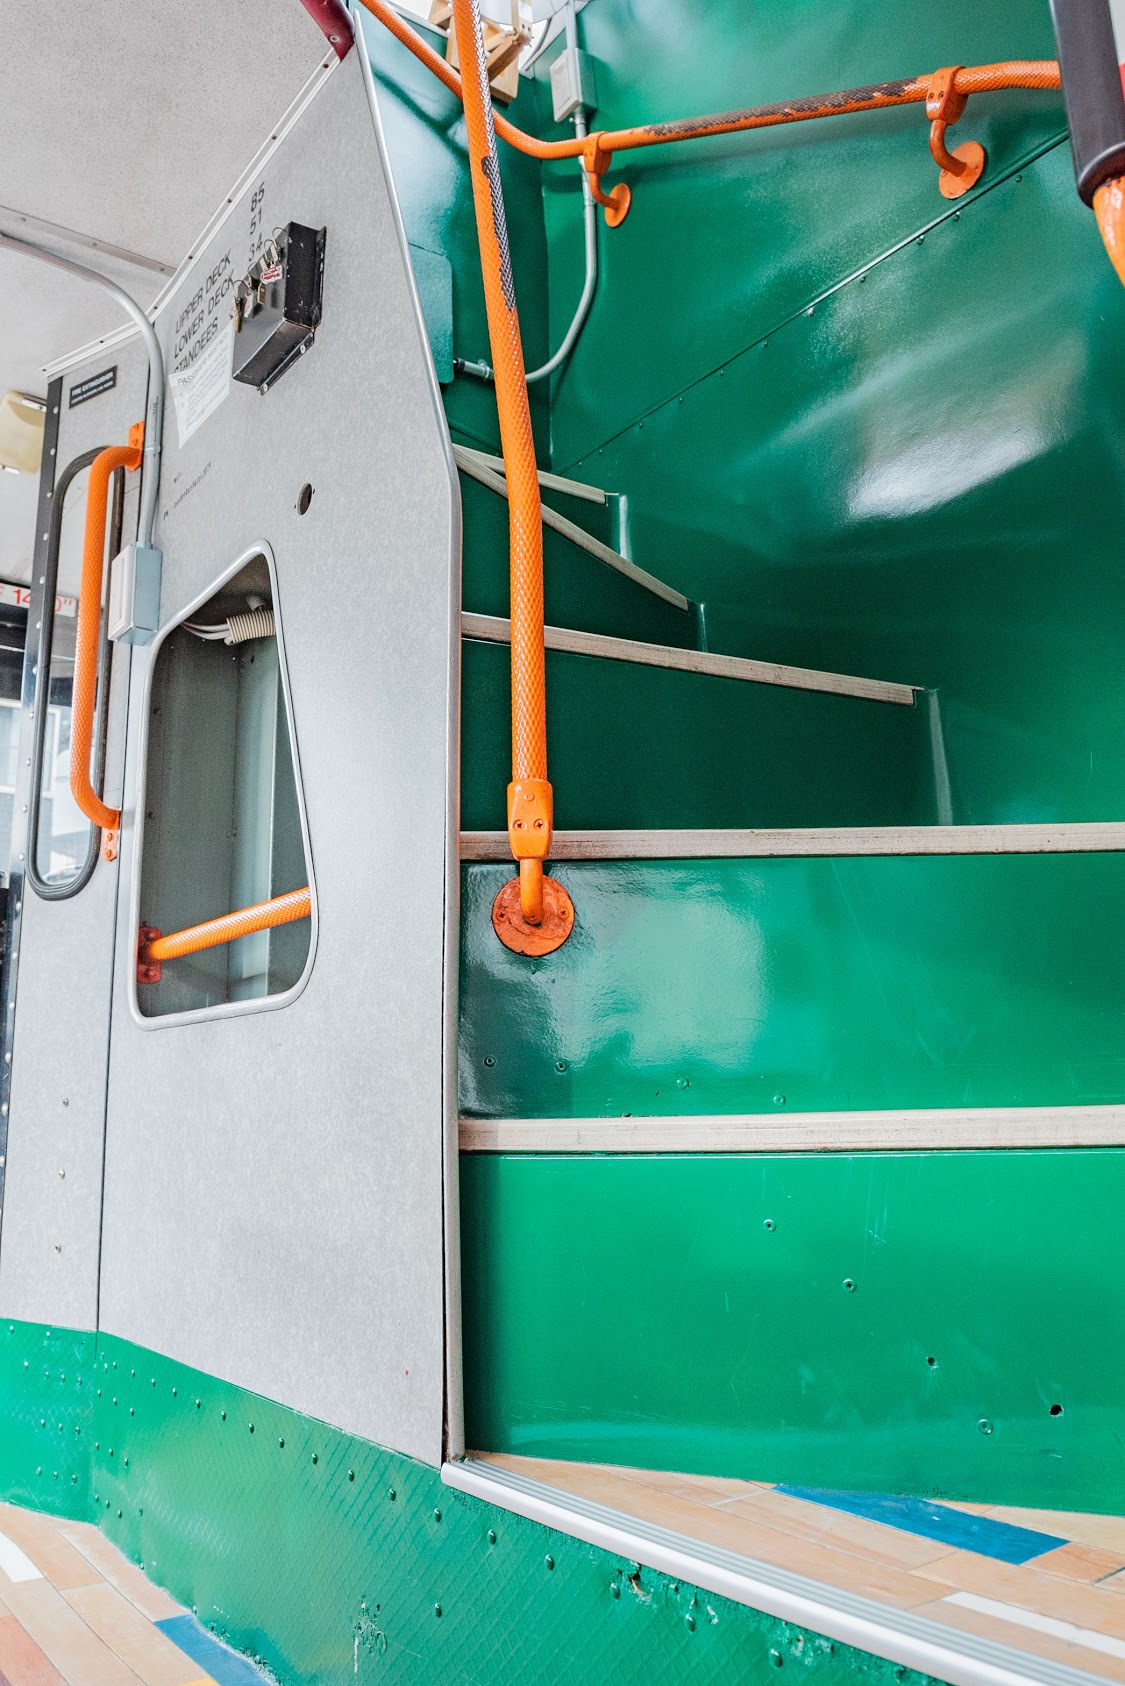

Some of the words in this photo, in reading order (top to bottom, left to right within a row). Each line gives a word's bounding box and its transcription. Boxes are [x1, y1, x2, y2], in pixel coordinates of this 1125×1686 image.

[250, 181, 266, 213] 85
[173, 309, 205, 359] LOWER
[207, 268, 235, 316] DECK
[248, 231, 264, 262] 34
[175, 286, 204, 334] UPPER
[205, 247, 232, 295] DECK
[249, 207, 263, 235] 51
